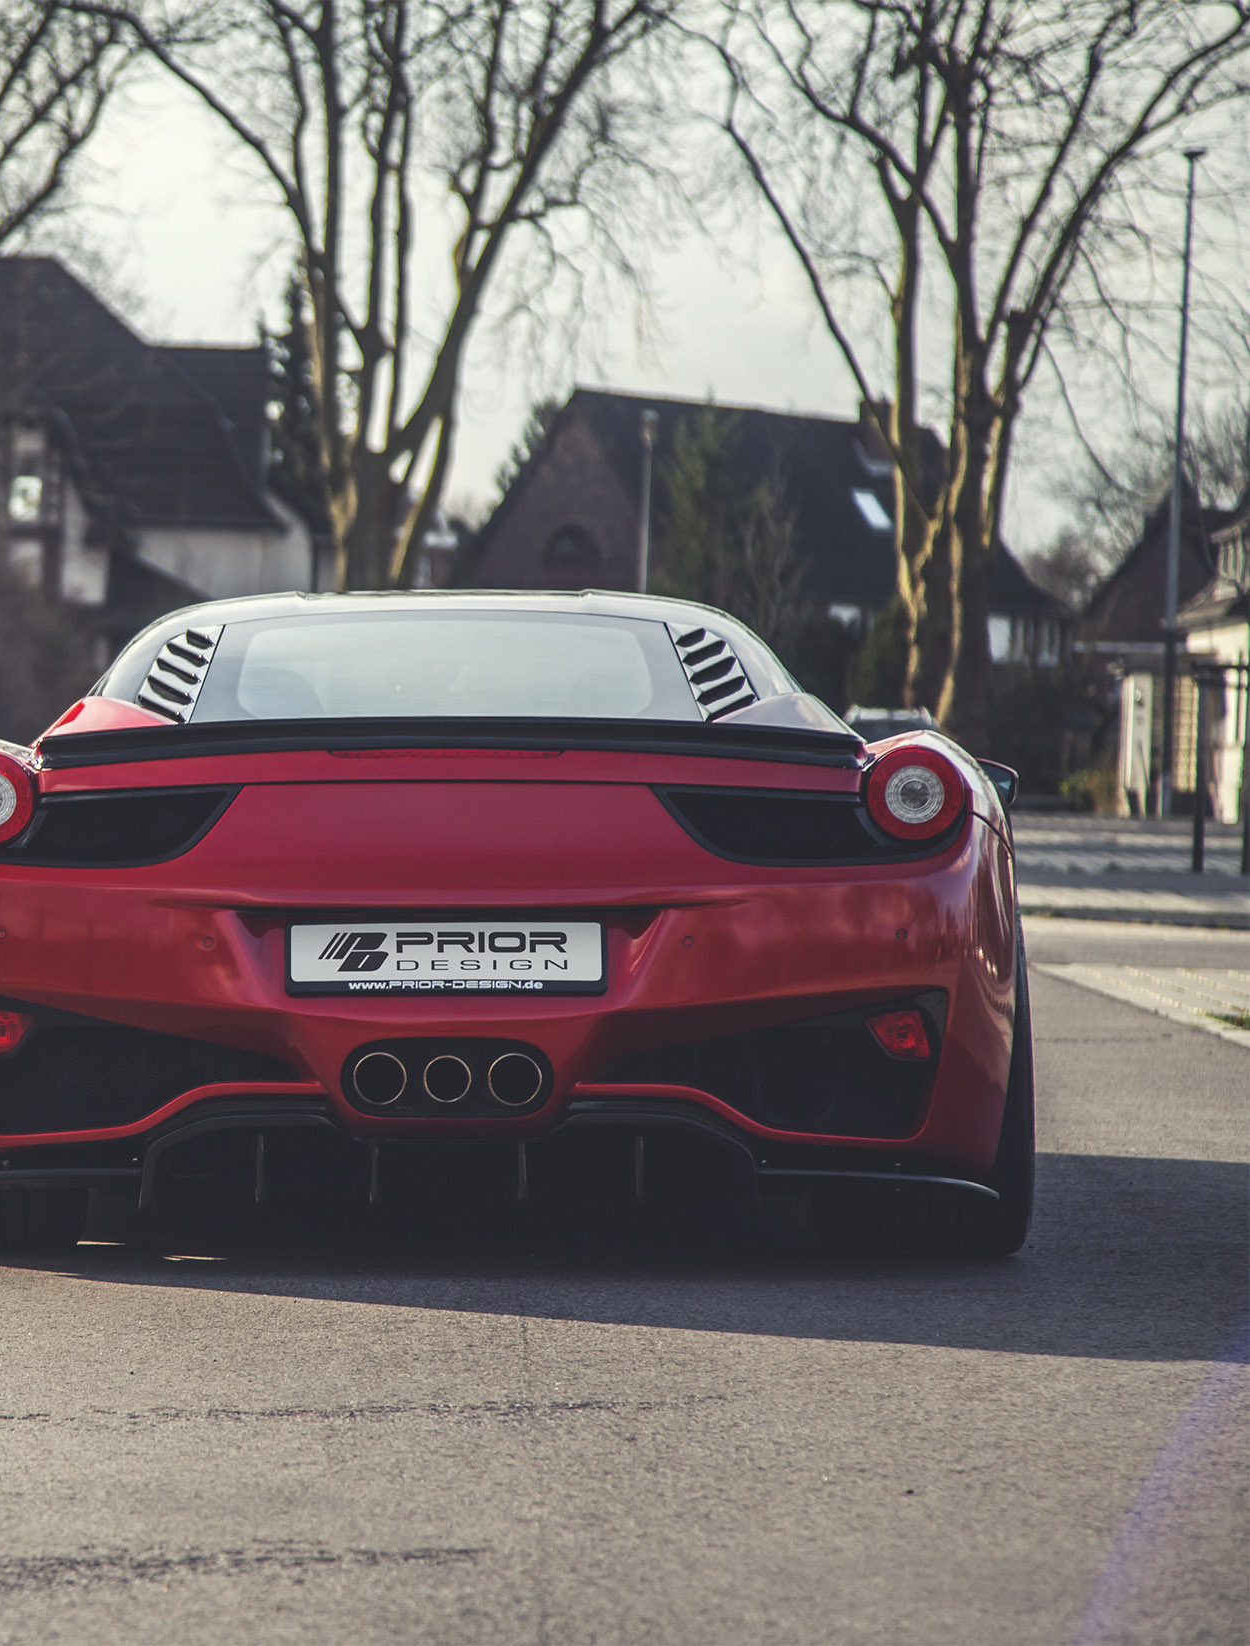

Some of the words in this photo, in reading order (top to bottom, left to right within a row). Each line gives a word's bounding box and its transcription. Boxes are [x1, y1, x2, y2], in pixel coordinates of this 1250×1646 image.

[396, 931, 567, 953] PRIOR
[396, 959, 568, 971] DESIGN
[348, 980, 544, 990] www.PRIOR-DESIGN.de
